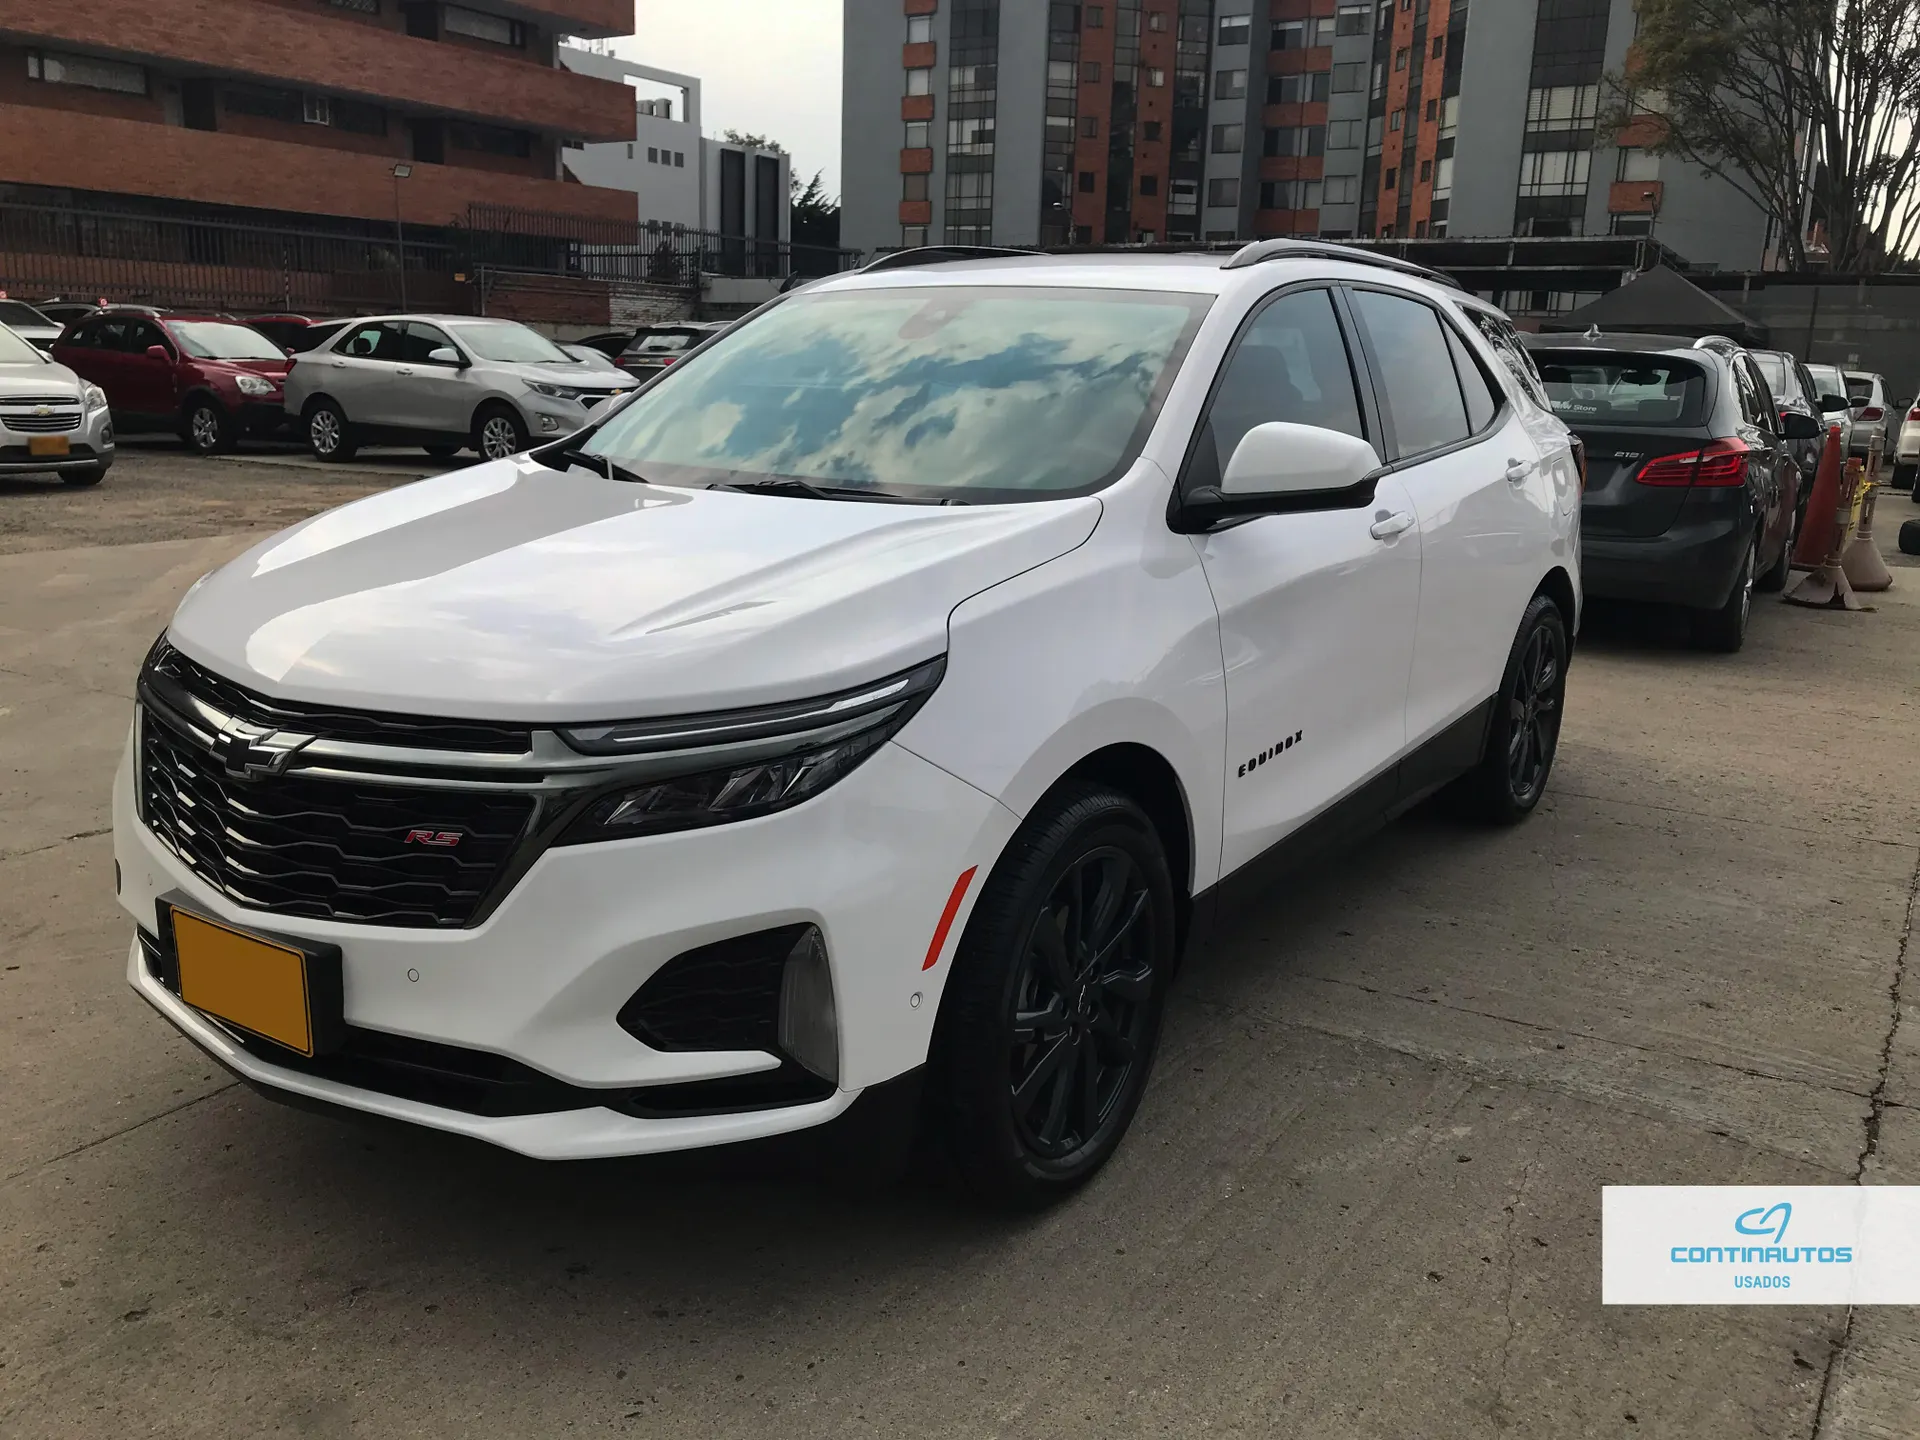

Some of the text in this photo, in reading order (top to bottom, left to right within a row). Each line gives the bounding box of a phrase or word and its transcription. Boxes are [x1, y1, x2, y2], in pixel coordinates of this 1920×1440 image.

[1573, 404, 1597, 412] Store
[1238, 729, 1303, 778] EQUINOX
[404, 829, 463, 847] RS
